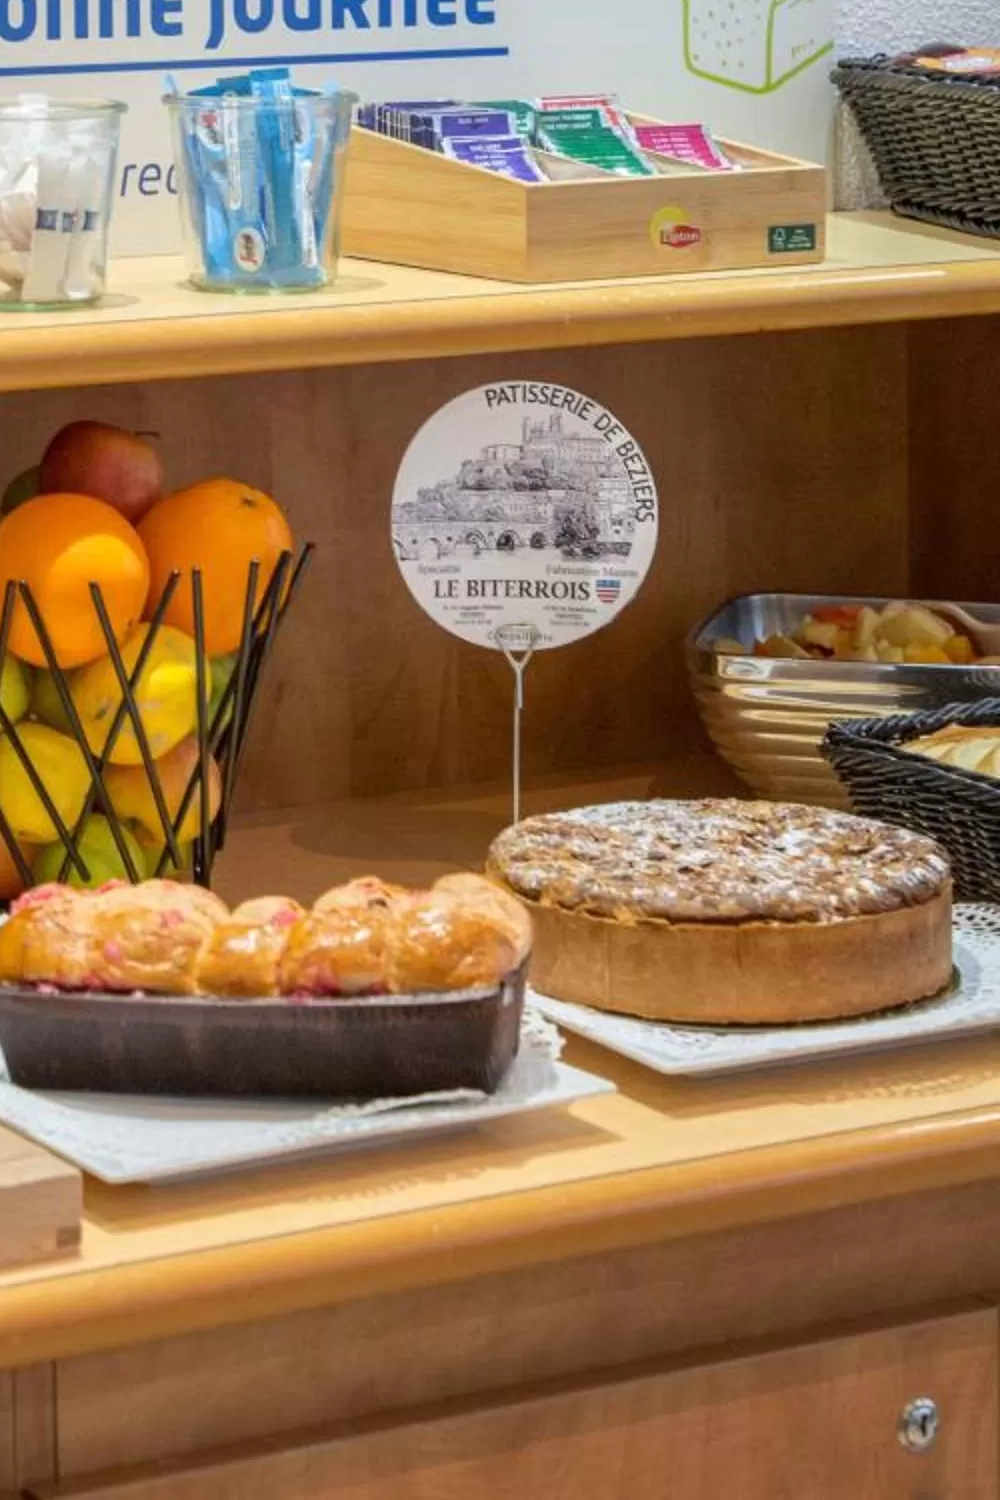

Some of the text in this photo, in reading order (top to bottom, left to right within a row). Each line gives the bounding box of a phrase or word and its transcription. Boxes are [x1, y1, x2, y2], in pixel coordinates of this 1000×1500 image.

[484, 384, 655, 523] PATISSERIE DE BEZIERS
[433, 579, 591, 601] LE BITERROIS
